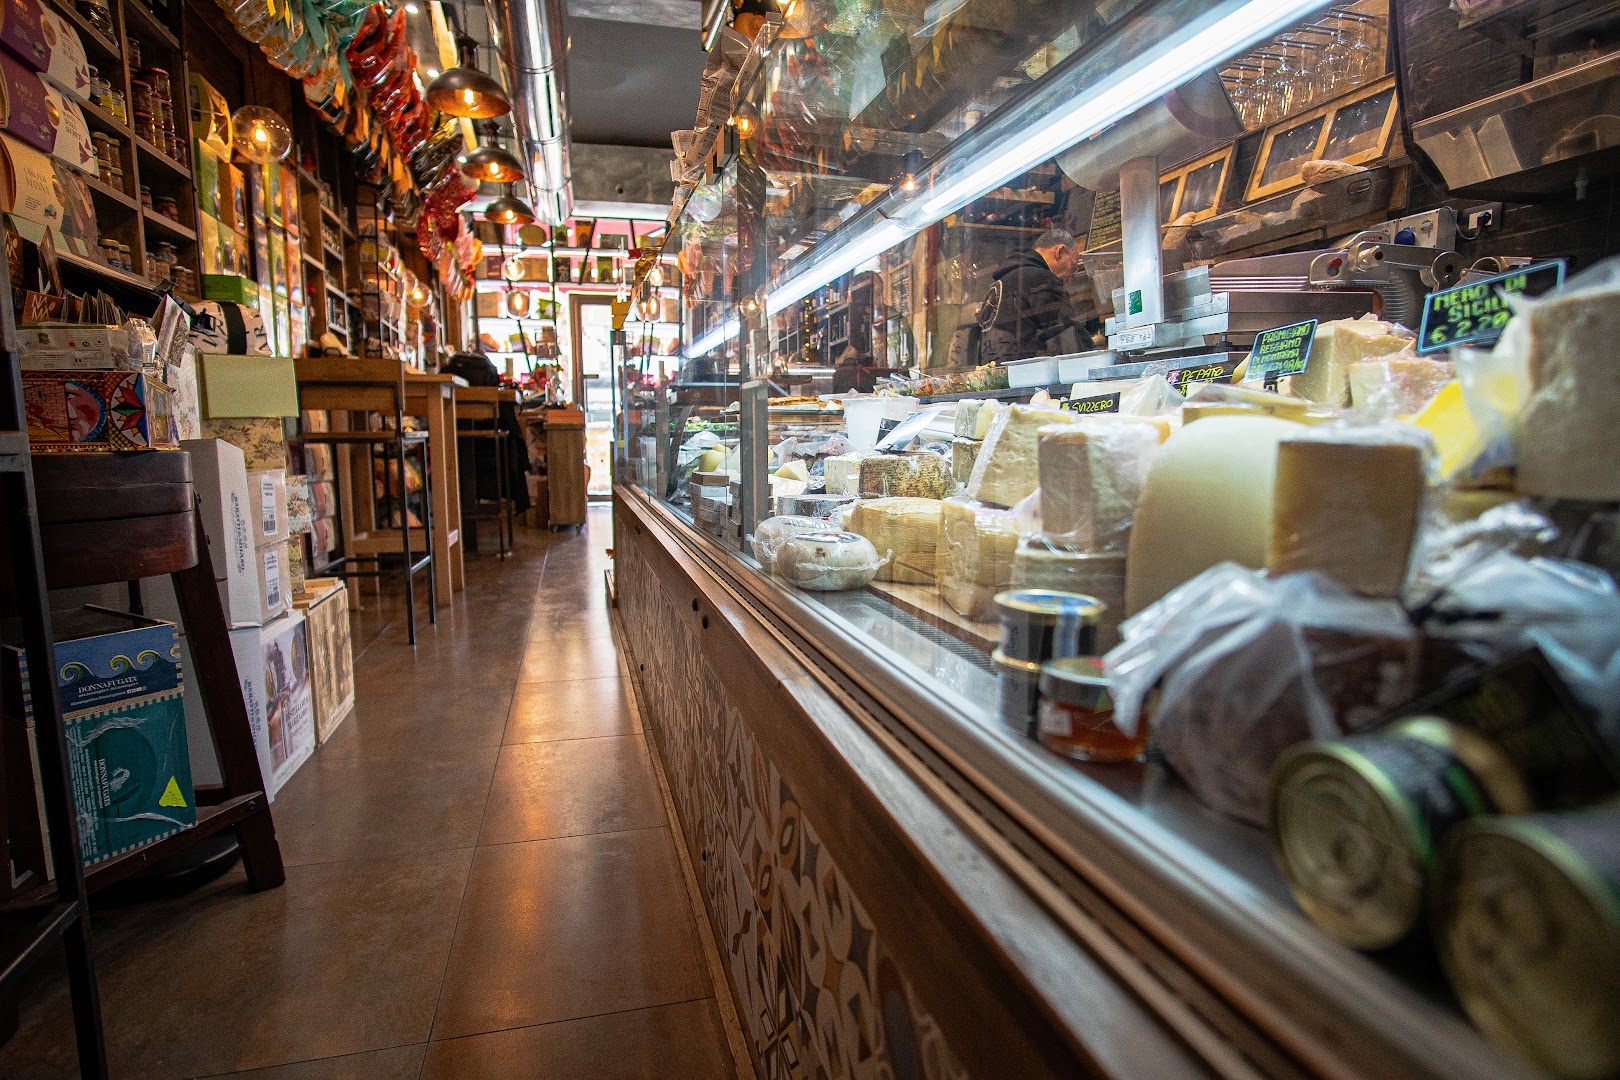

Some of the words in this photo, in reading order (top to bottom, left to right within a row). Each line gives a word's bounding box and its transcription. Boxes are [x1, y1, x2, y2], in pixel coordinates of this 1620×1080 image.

[1260, 337, 1302, 354] REGGIANO
[1181, 367, 1224, 383] PEPATO
[78, 676, 138, 694] DONNAFUGATA
[98, 758, 111, 807] DONNAFUGATA
